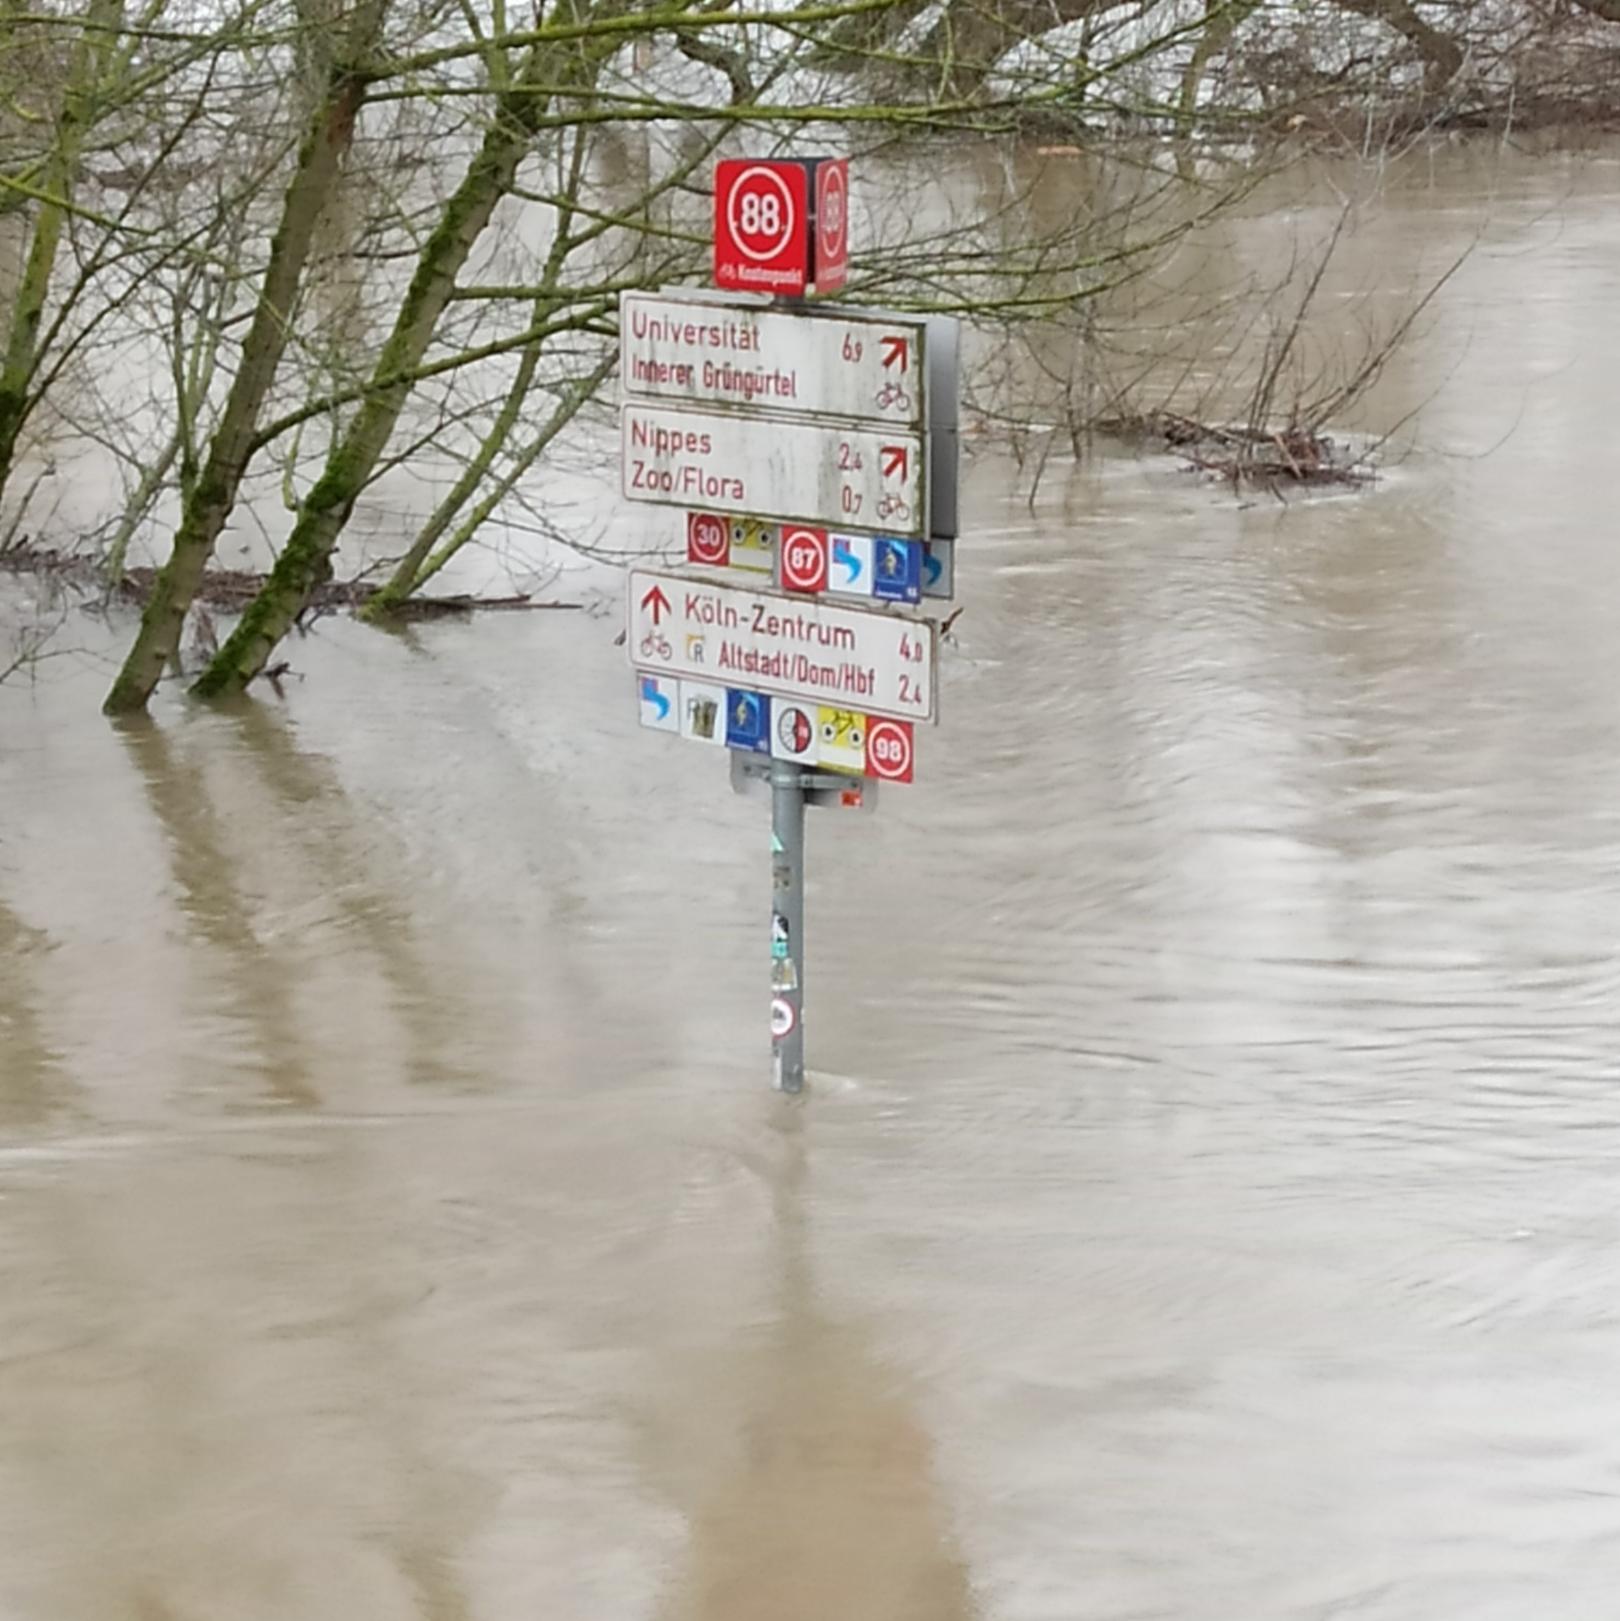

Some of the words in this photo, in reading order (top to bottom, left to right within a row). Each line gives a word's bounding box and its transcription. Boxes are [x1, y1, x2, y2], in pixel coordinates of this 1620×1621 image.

[740, 192, 780, 235] 88
[632, 310, 760, 352] Universität
[632, 354, 694, 386] Innerer
[703, 360, 797, 399] Grüngürtel
[631, 418, 712, 457] Nippes
[631, 460, 744, 500] Zoo/Flora
[697, 524, 720, 547] 30
[791, 547, 816, 570] 87
[685, 593, 855, 650] Köln-Zentrum
[718, 641, 875, 697] Altstadt/Dom/Hbf
[875, 736, 902, 763] 98
